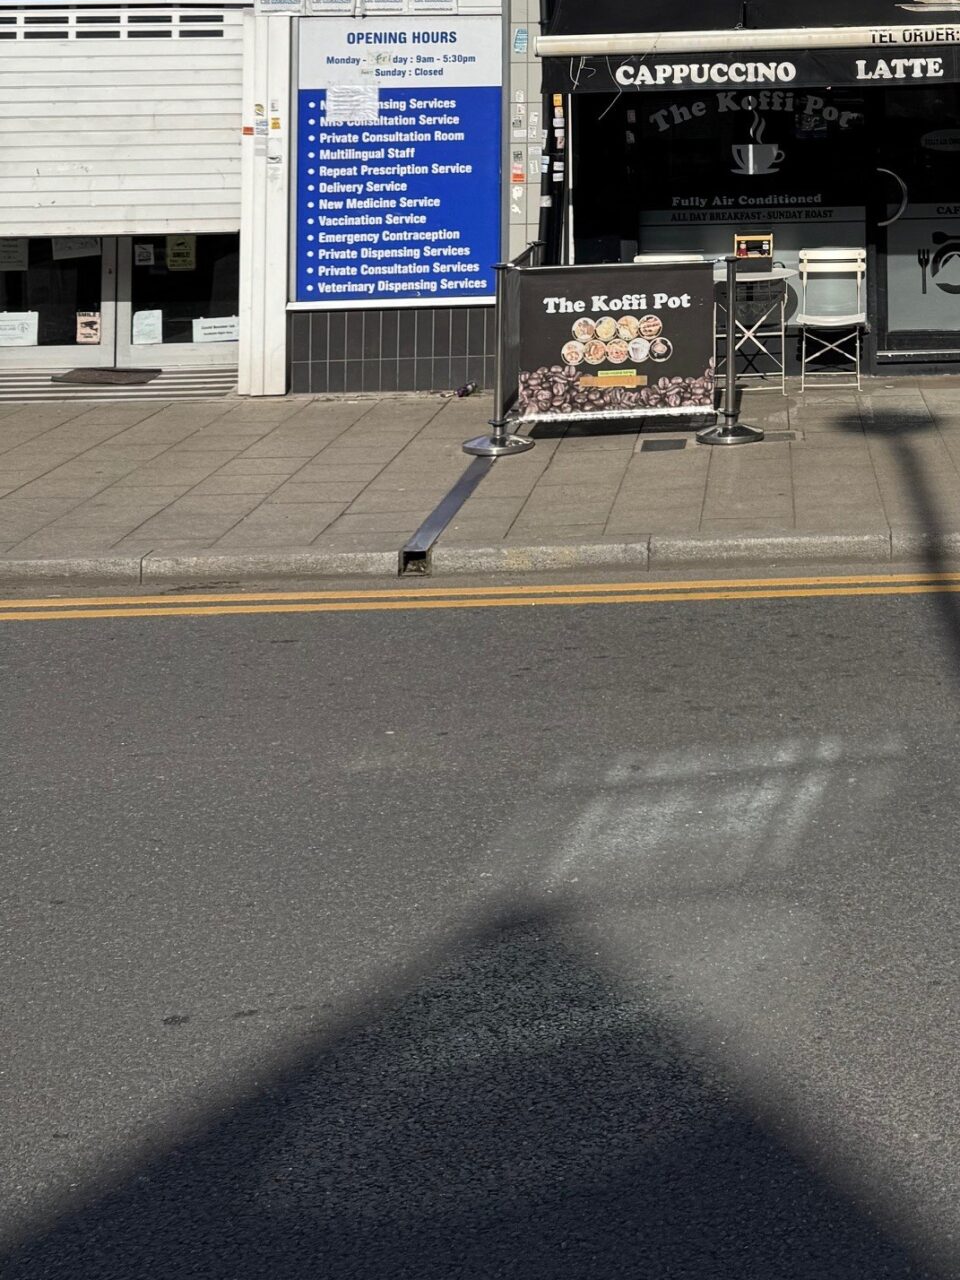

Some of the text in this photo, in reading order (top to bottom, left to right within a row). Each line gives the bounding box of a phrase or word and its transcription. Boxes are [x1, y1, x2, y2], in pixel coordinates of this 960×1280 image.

[347, 31, 457, 45] OPENING HOURS
[869, 30, 897, 44] TEL
[902, 27, 960, 42] ORDER:
[326, 56, 360, 66] Monday
[415, 55, 435, 63] 9am
[443, 55, 476, 64] 5:30pm
[375, 69, 406, 78] Sunday
[414, 68, 444, 77] Closed
[615, 61, 796, 86] CAPPUCCINO
[855, 58, 943, 80] LATTE
[409, 98, 456, 110] Services
[649, 100, 707, 133] The
[716, 91, 794, 113] Koffi
[419, 115, 460, 125] Service
[319, 131, 465, 143] Private Consultation Room
[319, 147, 416, 162] Multilingual Staff
[319, 163, 472, 178] Repeat Prescription Service
[319, 181, 408, 194] Delivery Service
[318, 196, 441, 210] New Medicine Service
[672, 193, 822, 208] Fully Air Conditioned
[318, 213, 427, 226] Vaccination Service
[671, 210, 834, 222] ALL DAY BREAKFAST SUNDAY ROAST
[318, 229, 460, 244] Emergency Contraception
[318, 245, 471, 260] Private Dispensing Services
[318, 261, 480, 276] Private Consultation Services
[317, 277, 488, 294] Veterinary Dispensing Services
[543, 293, 691, 314] The Koffi Pot
